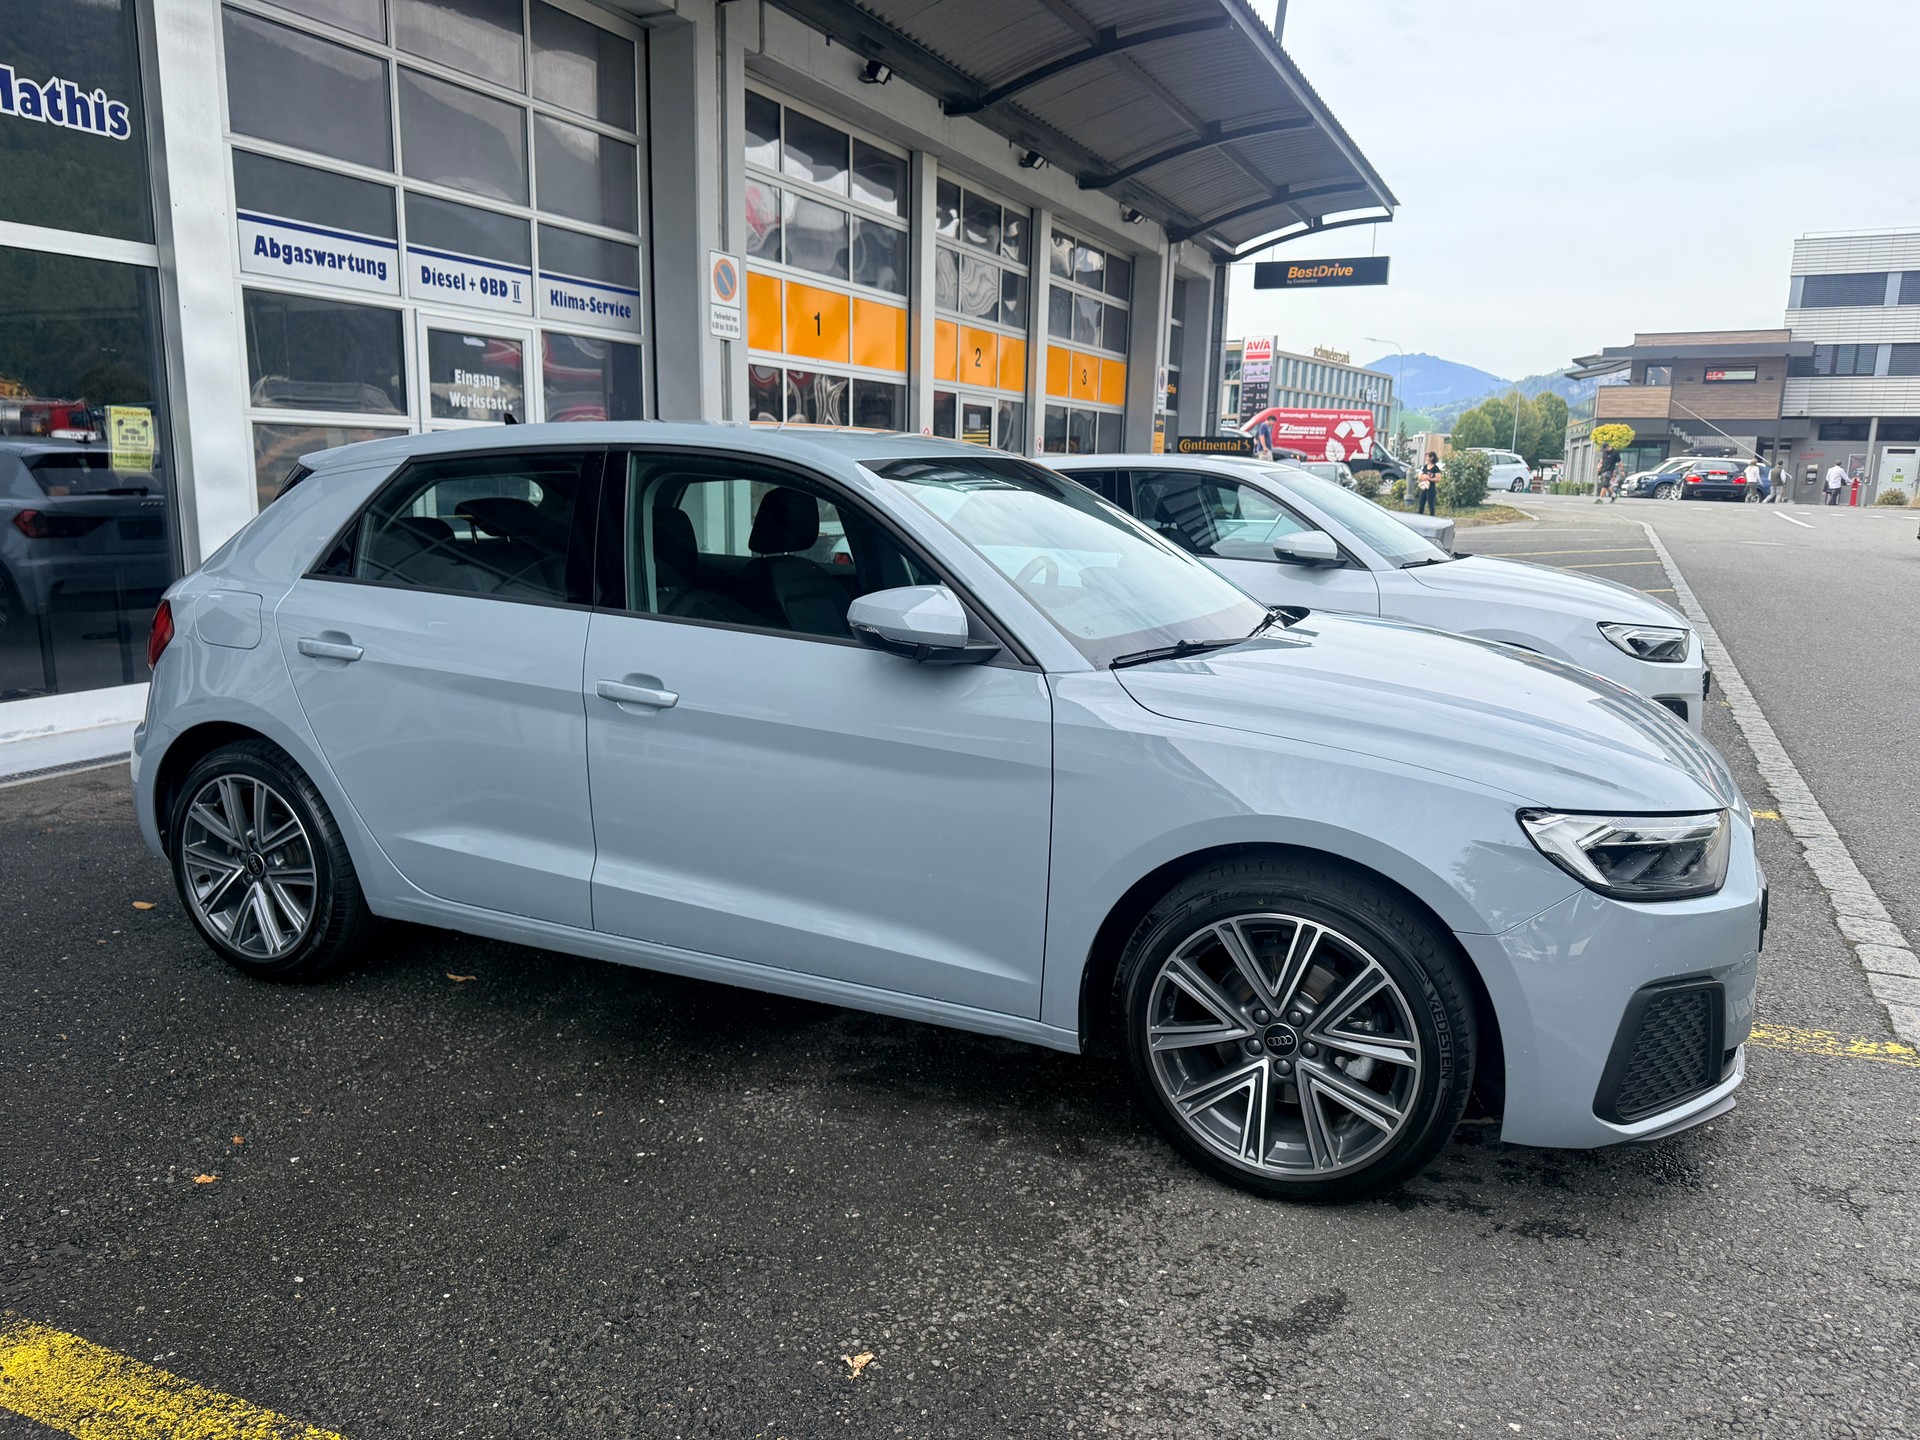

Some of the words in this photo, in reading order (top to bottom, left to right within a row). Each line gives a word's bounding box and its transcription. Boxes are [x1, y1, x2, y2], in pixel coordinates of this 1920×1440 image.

[254, 235, 387, 281] Abgaswartung
[1287, 262, 1353, 279] BestDrive
[421, 265, 466, 291] Diesel
[469, 277, 476, 291] +
[480, 276, 508, 298] OBD
[511, 280, 522, 304] II
[550, 289, 631, 319] Klima-Service
[814, 312, 821, 336] 1
[975, 348, 982, 367] 2
[454, 369, 500, 390] Eingang
[1082, 369, 1088, 385] 3
[1179, 439, 1241, 453] Continental
[1426, 989, 1454, 1080] VREDESTEIN
